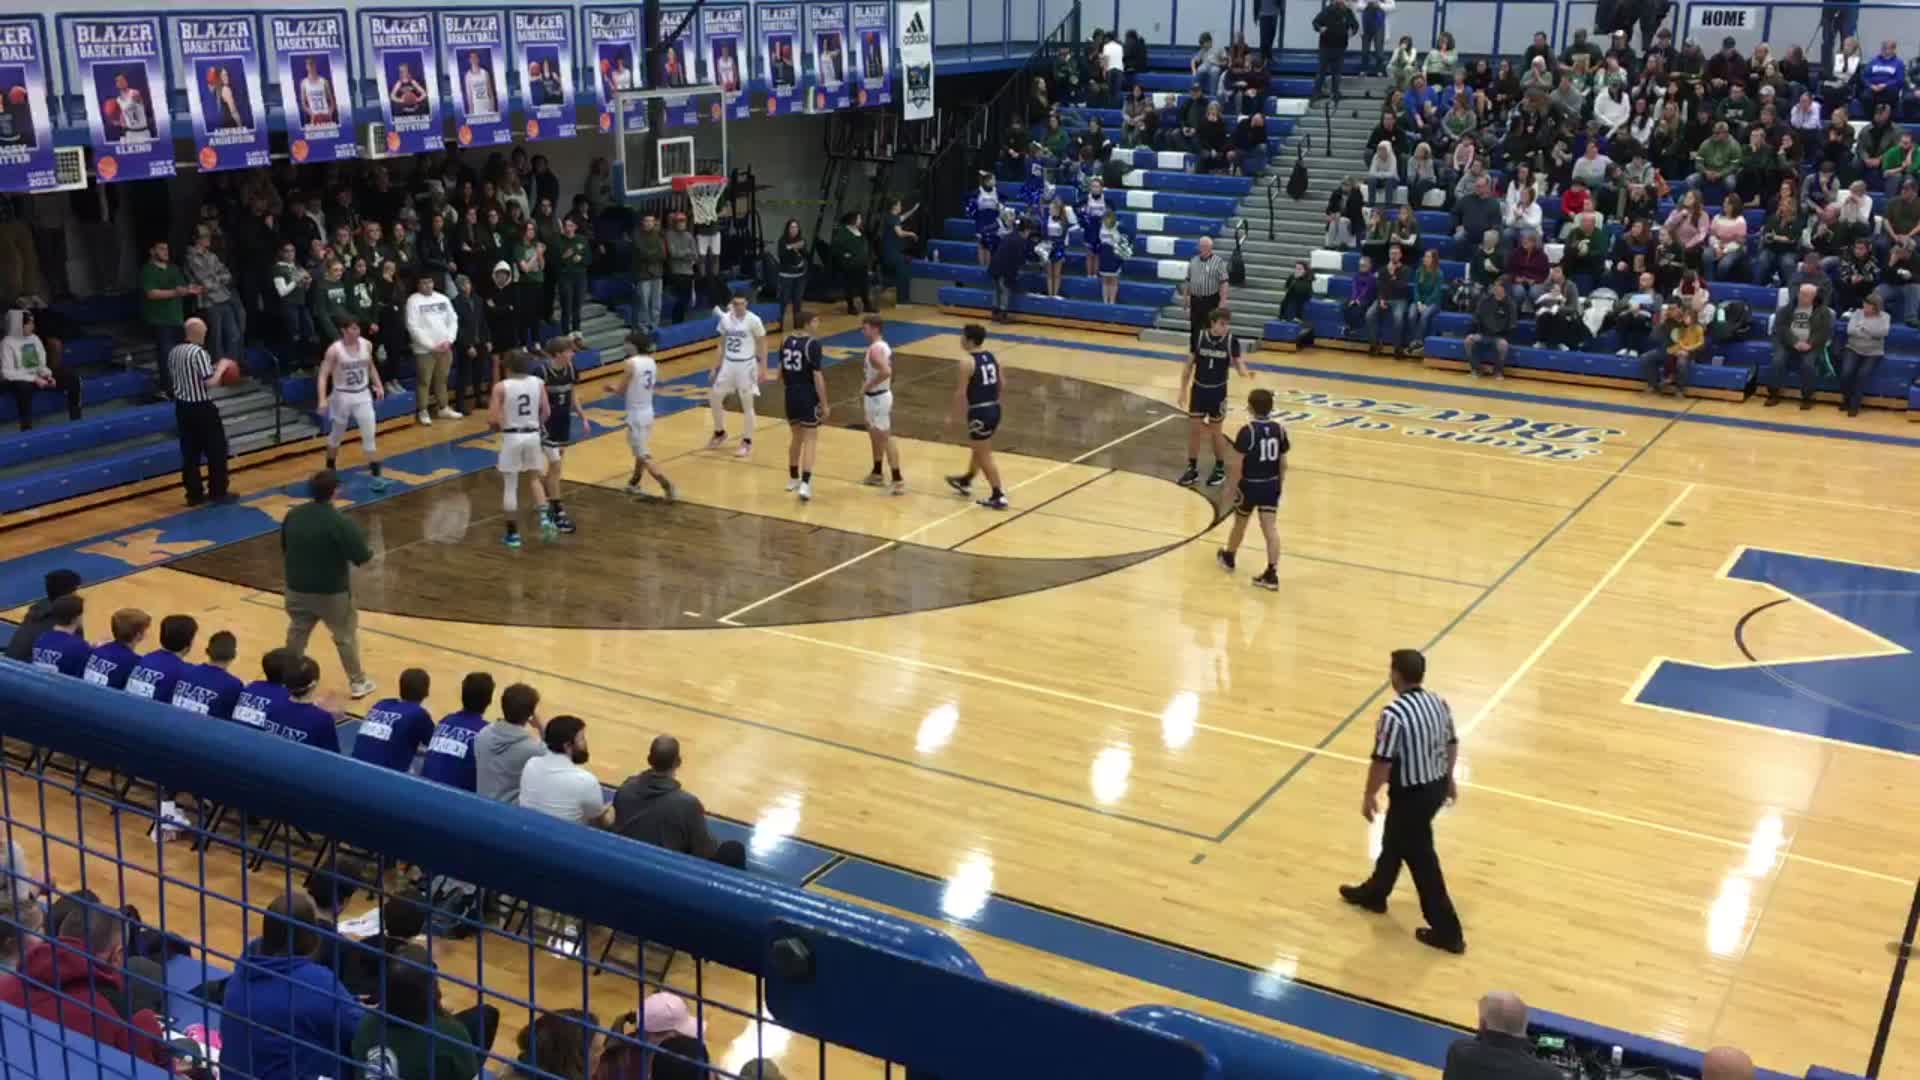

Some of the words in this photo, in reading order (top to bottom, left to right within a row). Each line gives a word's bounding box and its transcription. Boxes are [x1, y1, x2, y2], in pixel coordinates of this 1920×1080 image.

[372, 16, 429, 34] BLAZER
[446, 16, 498, 32] BLAZER
[516, 14, 565, 30] BLAZER
[1702, 10, 1746, 26] HOME
[76, 24, 153, 43] BLAZER
[181, 21, 249, 40] BLAZER
[274, 19, 338, 37] BLAZER
[183, 38, 251, 54] BASKETBALL
[277, 36, 340, 51] BASKETBALL
[903, 34, 928, 46] adidas
[79, 42, 156, 59] BASKETBALL
[727, 336, 741, 352] 22
[783, 349, 802, 371] 23
[1208, 358, 1214, 369] 1
[643, 370, 653, 390] 3
[981, 362, 997, 385] 13
[517, 393, 531, 417] 2
[1259, 437, 1279, 462] 10
